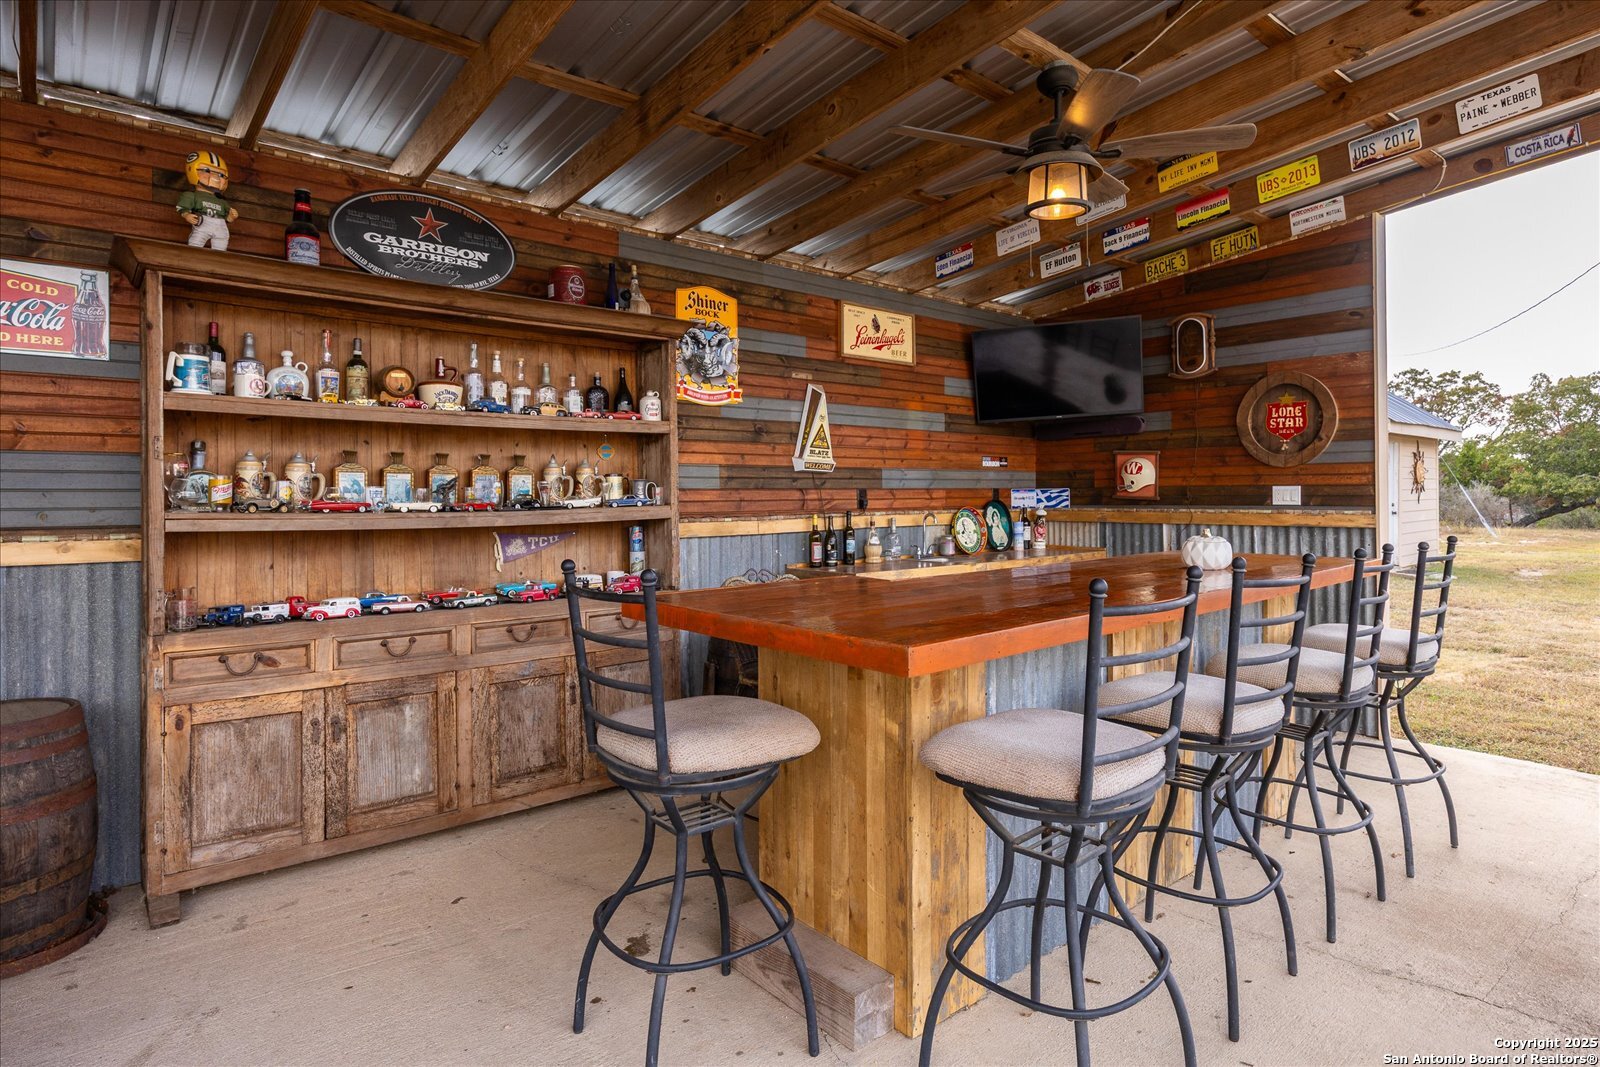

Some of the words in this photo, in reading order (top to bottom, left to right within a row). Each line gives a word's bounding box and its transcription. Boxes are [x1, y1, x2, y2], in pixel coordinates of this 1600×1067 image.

[1481, 86, 1511, 100] TEXAS
[1460, 105, 1489, 122] PAINE
[1500, 87, 1537, 107] WEBBER
[1354, 142, 1376, 160] UBS
[1384, 128, 1416, 151] 2012
[1514, 142, 1542, 158] COSTA
[1543, 134, 1565, 149] RICA
[1170, 168, 1184, 179] LIFE
[1187, 163, 1197, 173] INV
[1260, 177, 1280, 194] UBS
[1288, 164, 1317, 184] 2013
[1178, 209, 1200, 221] Lincoln
[1200, 198, 1228, 214] Financial
[1293, 213, 1324, 227] NORTHWESTERN
[1326, 208, 1342, 216] MUTUAL
[1115, 222, 1136, 233] TEXAS
[363, 231, 490, 263] GARRISON
[1104, 238, 1117, 248] Back
[1123, 228, 1149, 240] Financial
[1213, 241, 1226, 257] EF
[1230, 231, 1257, 252] HUTN
[1045, 260, 1053, 271] EF
[1054, 253, 1077, 267] Hutton
[1146, 257, 1177, 278] BACHE
[1180, 254, 1186, 267] 3
[6, 279, 59, 297] COLD
[684, 291, 729, 312] Shiner
[695, 308, 720, 319] BOCK
[16, 333, 64, 346] HERE
[850, 324, 905, 350] Leinenkugel's
[1271, 406, 1302, 417] LONE
[1270, 417, 1303, 428] STAR
[1126, 462, 1142, 475] W
[527, 535, 560, 550] TCU
